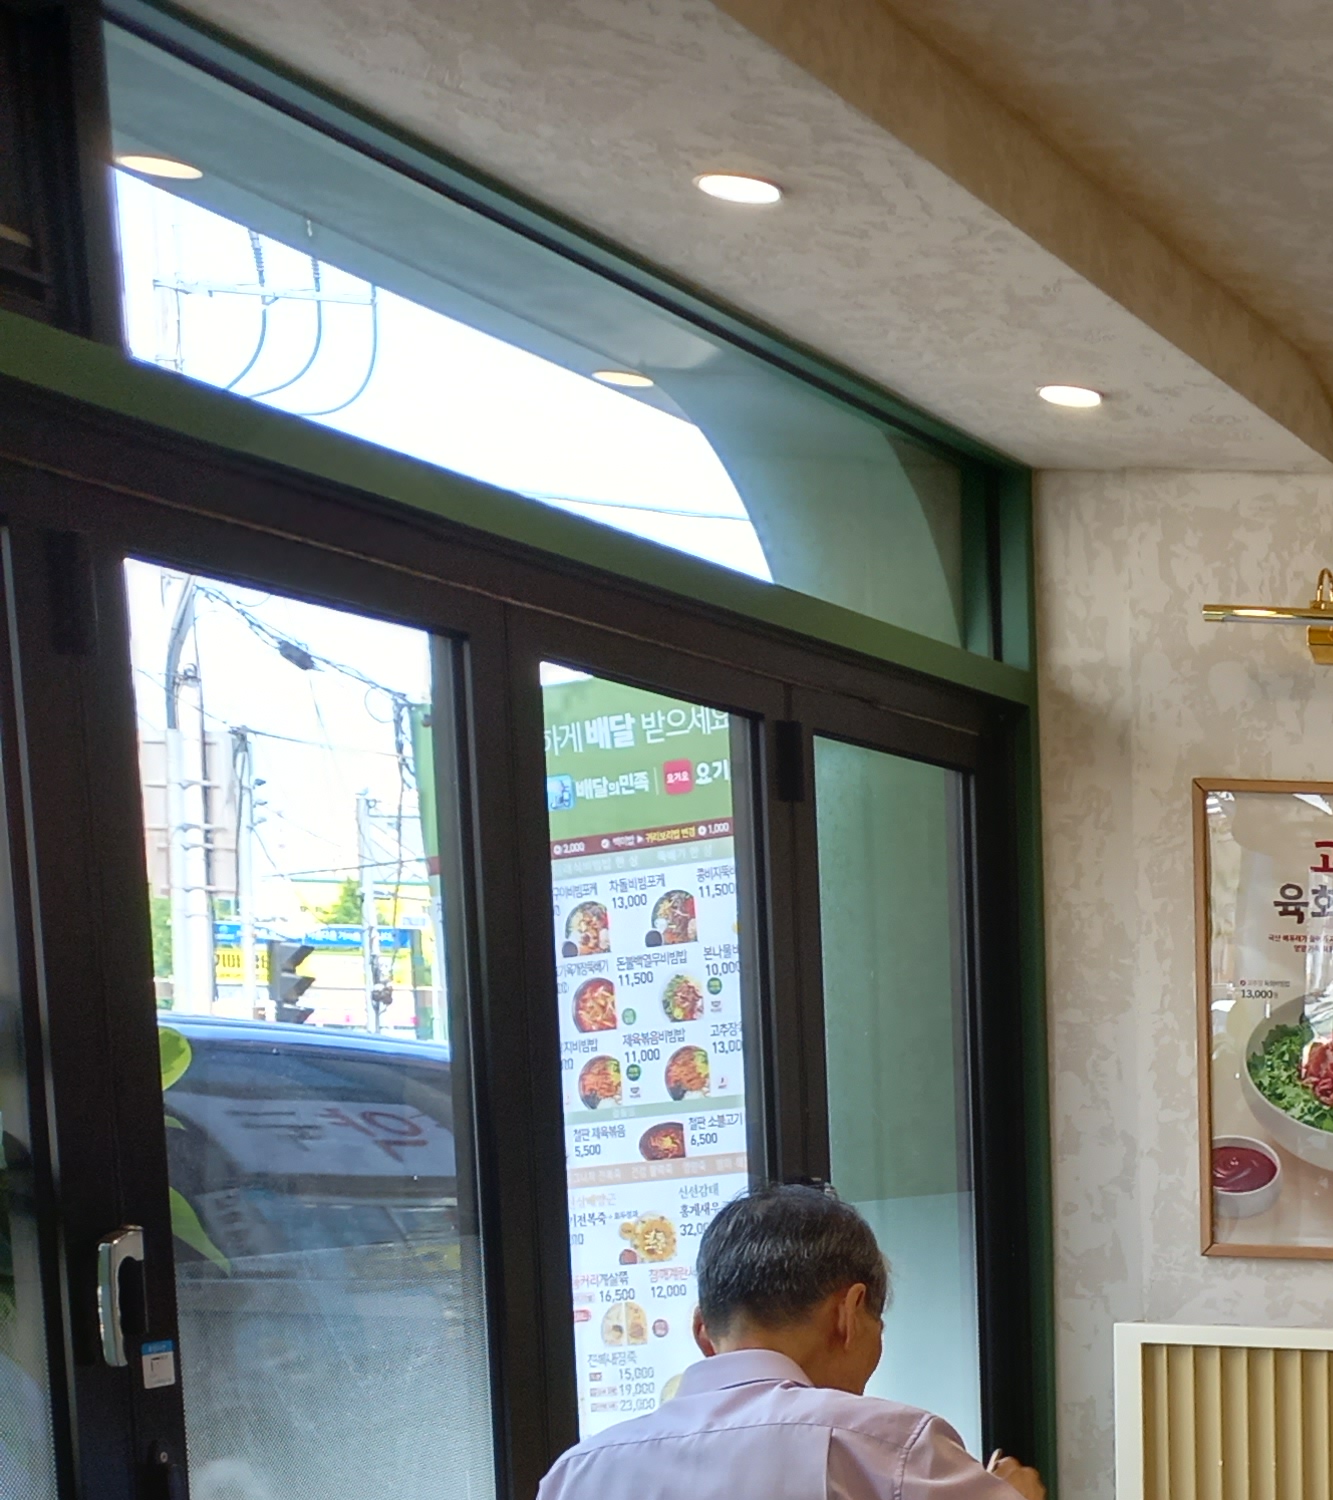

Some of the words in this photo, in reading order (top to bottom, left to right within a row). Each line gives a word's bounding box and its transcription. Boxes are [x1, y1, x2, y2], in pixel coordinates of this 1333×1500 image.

[584, 712, 636, 750] 배달
[641, 706, 730, 745] 받으세요
[695, 759, 730, 785] 요기
[575, 771, 650, 800] 배달의민족
[707, 822, 730, 835] 1,000
[562, 842, 586, 853] 2,000
[608, 872, 666, 893] 차돌비빔포케
[698, 883, 735, 899] 11,500
[612, 893, 648, 909] 13,000
[618, 971, 654, 987] 11,500
[622, 1027, 686, 1047] 제육볶음비빔밥
[712, 1039, 742, 1055] 13,00
[624, 1048, 660, 1064] 11,000
[689, 1116, 707, 1131] 철판
[708, 1112, 743, 1128] 소불고기
[573, 1128, 591, 1143] 철판
[591, 1124, 626, 1140] 제육볶음
[690, 1133, 718, 1146] 6,500
[574, 1144, 601, 1157] 5,500
[678, 1183, 720, 1200] 신선감태
[679, 1202, 721, 1218] 홍게새우
[680, 1223, 709, 1236] 32,0
[599, 1288, 636, 1303] 16,500
[651, 1284, 688, 1299] 12,000
[619, 1367, 655, 1382] 15,000
[619, 1382, 656, 1398] 19,000
[620, 1398, 657, 1412] 23,000
